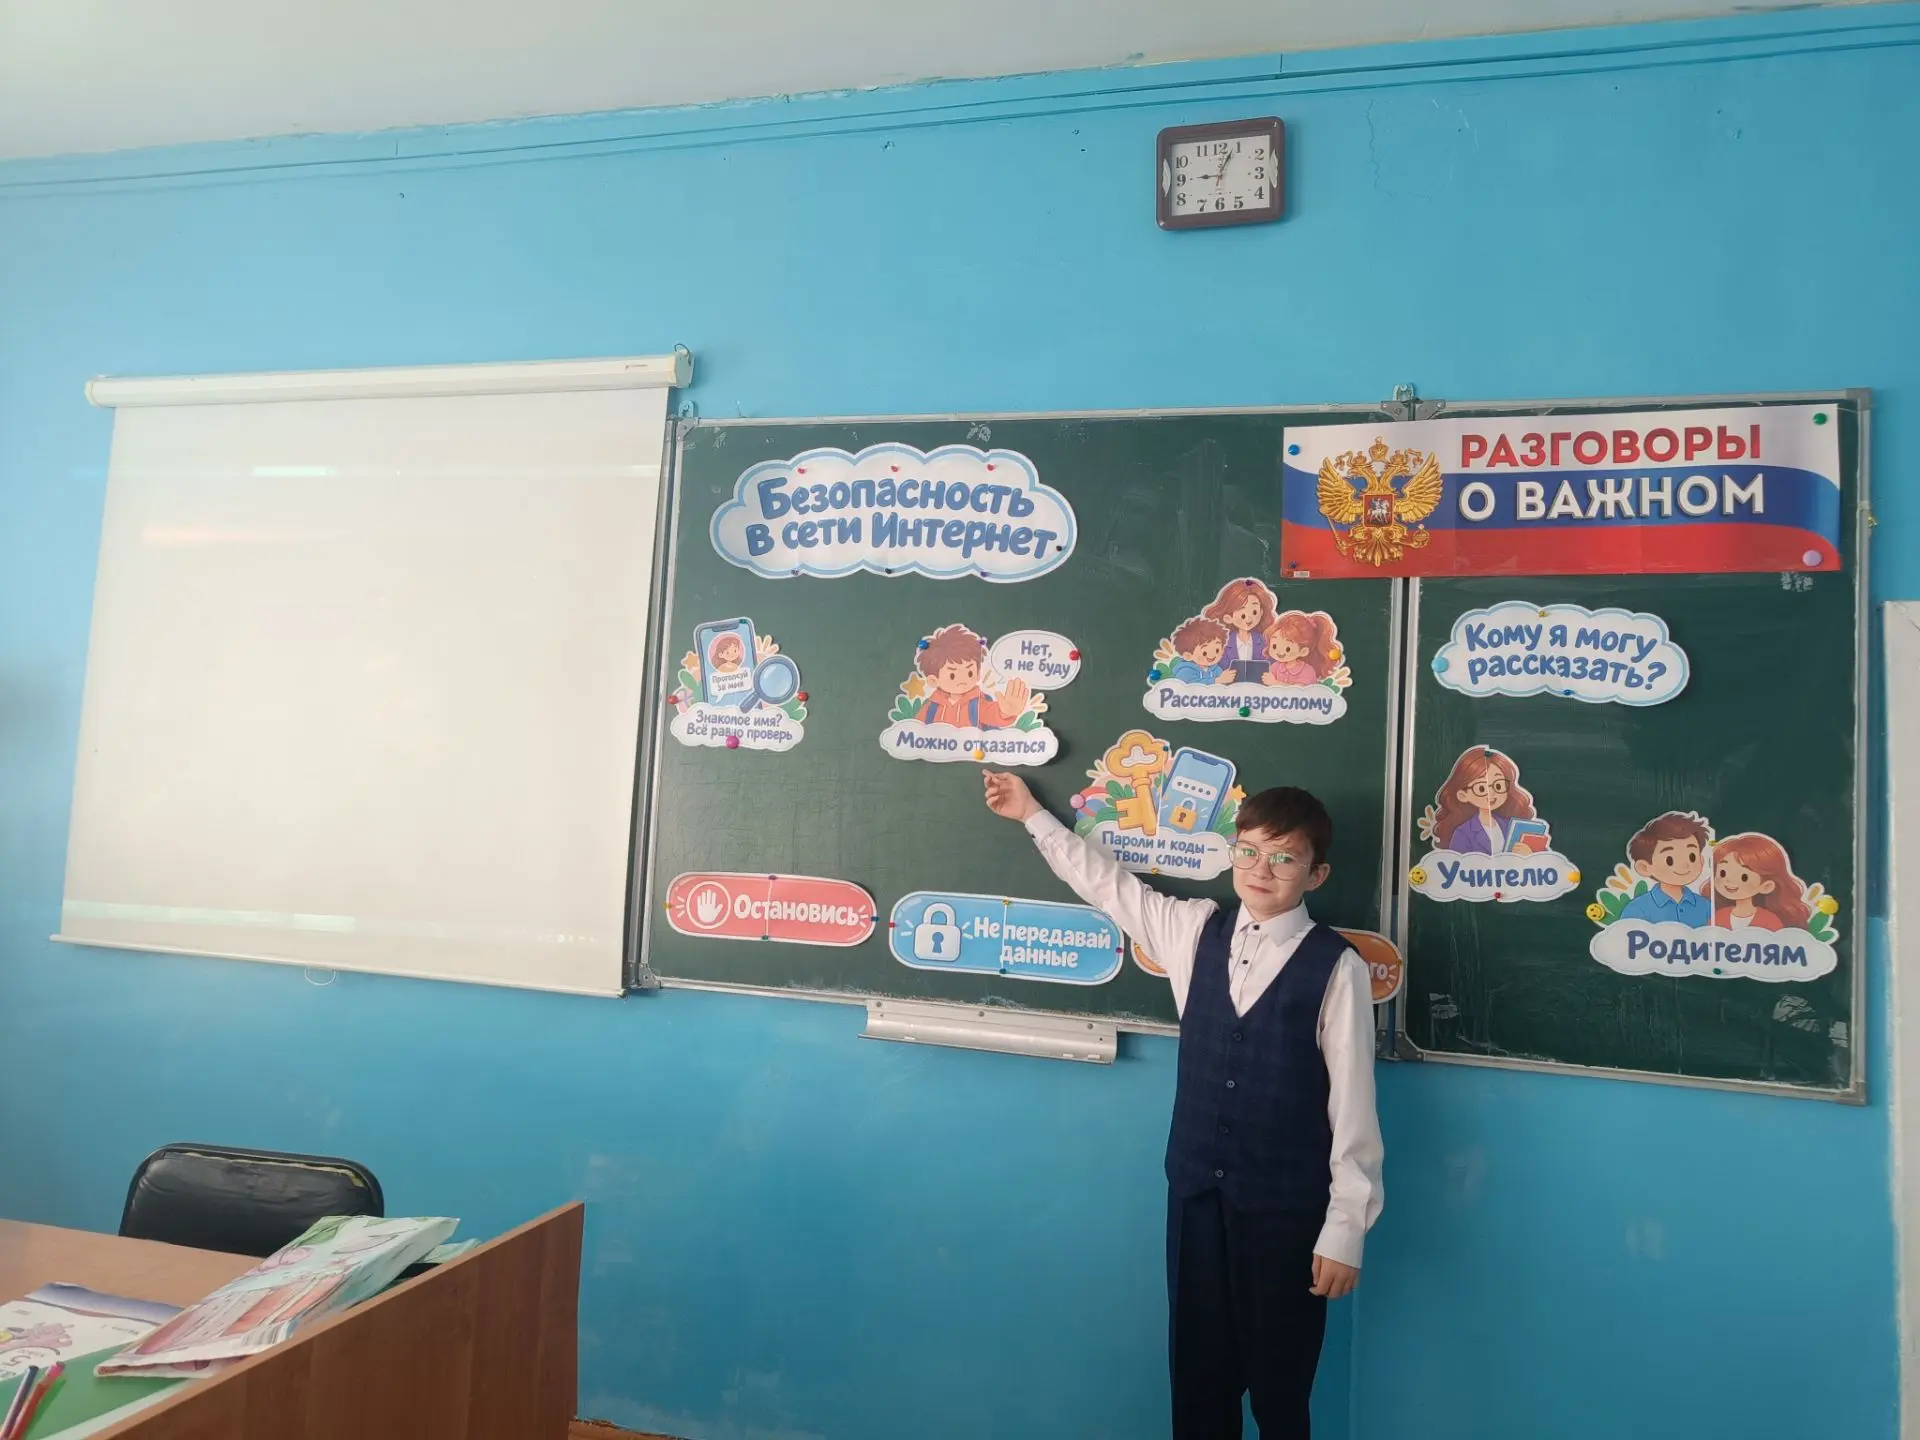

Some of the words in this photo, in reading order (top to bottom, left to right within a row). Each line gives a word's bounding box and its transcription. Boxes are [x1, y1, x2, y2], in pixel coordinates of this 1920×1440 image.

[1196, 145, 1208, 157] 11
[1212, 143, 1228, 155] 12
[1236, 141, 1241, 153] 1
[1254, 149, 1264, 160] 2
[1176, 156, 1188, 168] 10
[1177, 174, 1186, 187] 9
[1254, 167, 1264, 179] 3
[1176, 193, 1186, 206] 8
[1234, 196, 1244, 209] 5
[1254, 186, 1264, 200] 4
[1197, 199, 1207, 212] 7
[1215, 198, 1225, 210] 6
[1460, 424, 1761, 468] РАЗГОВОРЫ
[757, 476, 1035, 520] Безопасность
[1458, 482, 1495, 521] О
[1516, 473, 1765, 521] ВАЖНОМ
[782, 517, 862, 550] сети
[871, 511, 1057, 559] Интернет
[1020, 640, 1052, 658] Нет,
[1465, 622, 1543, 651] Кому
[1575, 627, 1658, 663] могу
[1004, 660, 1013, 670] я
[1018, 660, 1034, 672] не
[1038, 659, 1071, 679] буду
[1467, 654, 1667, 690] рассказать?
[1159, 688, 1241, 709] Расскажи
[1244, 691, 1333, 715] взрослому
[753, 714, 783, 727] имя?
[687, 722, 707, 735] Всё
[747, 728, 793, 743] проверь
[896, 731, 958, 751] Можно
[963, 738, 1046, 754] отказаться
[1102, 830, 1154, 851] Пароли
[1157, 838, 1165, 849] и
[1170, 839, 1205, 855] коды
[1113, 849, 1148, 864] твои
[1437, 860, 1558, 889] Учителю
[733, 894, 860, 926] Остановись
[973, 916, 1000, 938] Не
[1003, 924, 1111, 949] передавай
[1000, 944, 1079, 968] данные
[1627, 930, 1808, 967] Родителям
